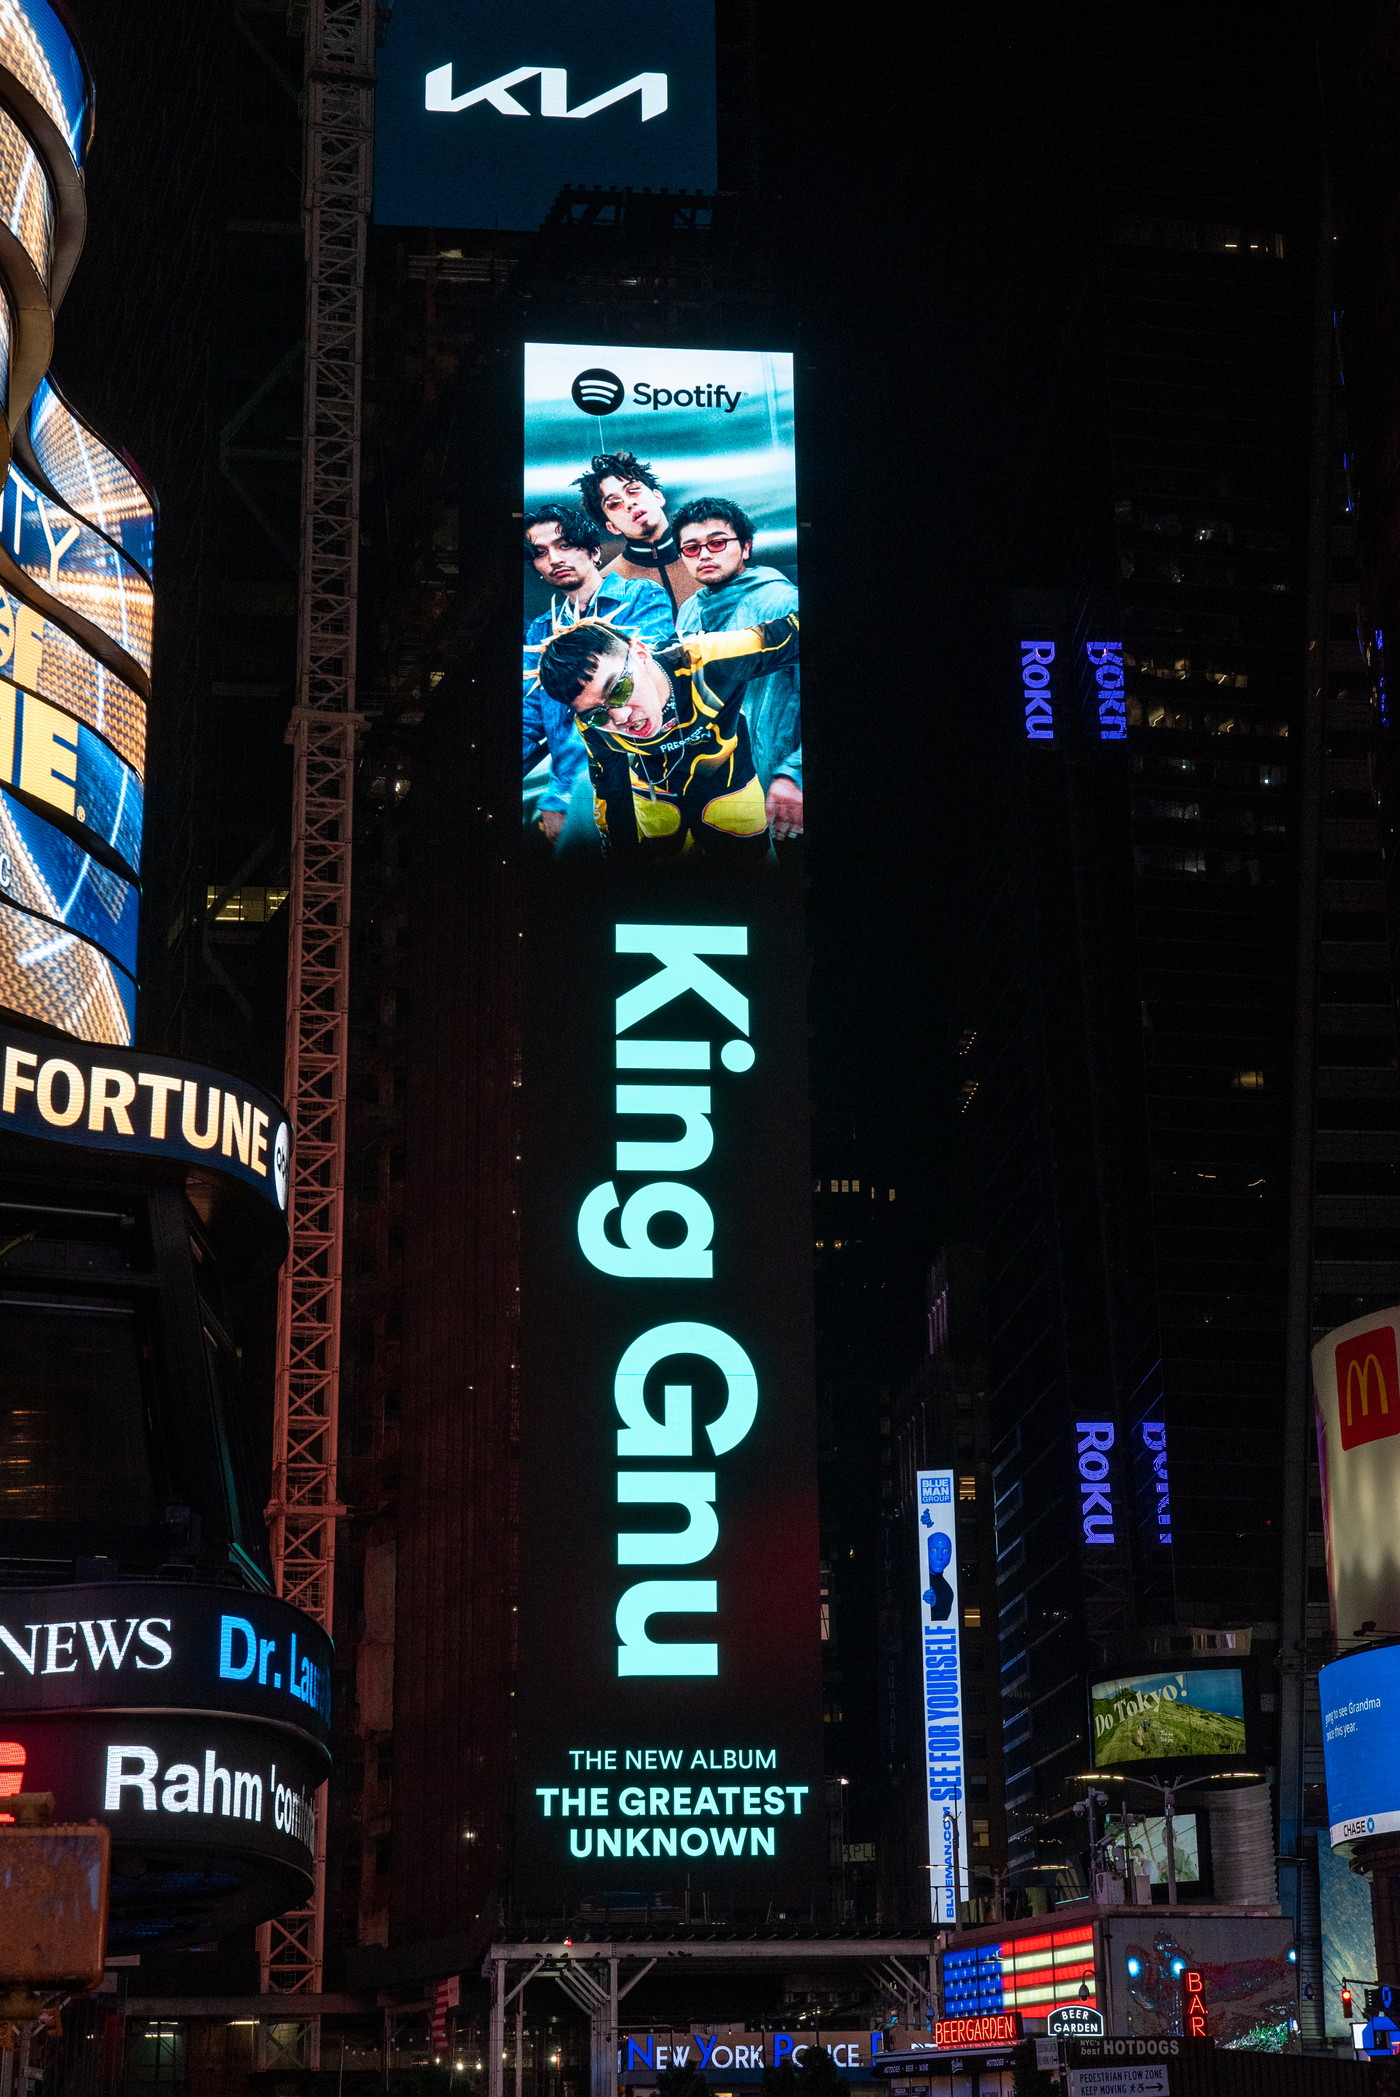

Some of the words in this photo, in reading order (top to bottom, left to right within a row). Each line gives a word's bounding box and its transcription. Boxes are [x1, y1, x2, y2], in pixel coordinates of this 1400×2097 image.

[633, 382, 742, 413] Spotify
[2, 1046, 269, 1177] FORTUNE
[578, 924, 755, 1278] King
[922, 1479, 949, 1488] BLUE
[922, 1487, 950, 1496] MAN
[614, 1321, 758, 1677] Gnu
[922, 1495, 950, 1503] GROUP
[0, 1618, 172, 1675] NEWS
[219, 1615, 281, 1688] Dr.
[925, 1625, 959, 1722] YOURSELF
[1095, 1713, 1113, 1738] Do
[1113, 1674, 1187, 1723] Tokyo!
[1339, 1706, 1348, 1718] see
[1348, 1698, 1381, 1715] Grandma
[928, 1724, 961, 1763] FOR
[1343, 1722, 1358, 1738] year.
[569, 1750, 617, 1770] THE
[625, 1750, 683, 1770] NEW
[690, 1749, 776, 1769] ALBUM
[104, 1745, 261, 1822] Rahm
[929, 1766, 962, 1802] SEE
[536, 1788, 608, 1816] THE
[618, 1786, 809, 1816] GREATEST
[570, 1827, 775, 1858] UNKNOWN
[1343, 1820, 1366, 1837] CHASE
[1062, 2009, 1089, 2021] BEER
[1188, 1972, 1205, 2037] BAR
[935, 2016, 1013, 2044] BEERGARDEN
[1053, 2023, 1098, 2033] GARDEN
[1080, 2047, 1100, 2056] best
[1103, 2040, 1179, 2055] HOTDOGS
[1079, 2071, 1123, 2083] PEDESTRIAN
[1123, 2070, 1142, 2081] FLOW
[1144, 2069, 1164, 2080] ZONE
[1080, 2085, 1098, 2096] KEEP
[1100, 2084, 1127, 2094] MOVING
